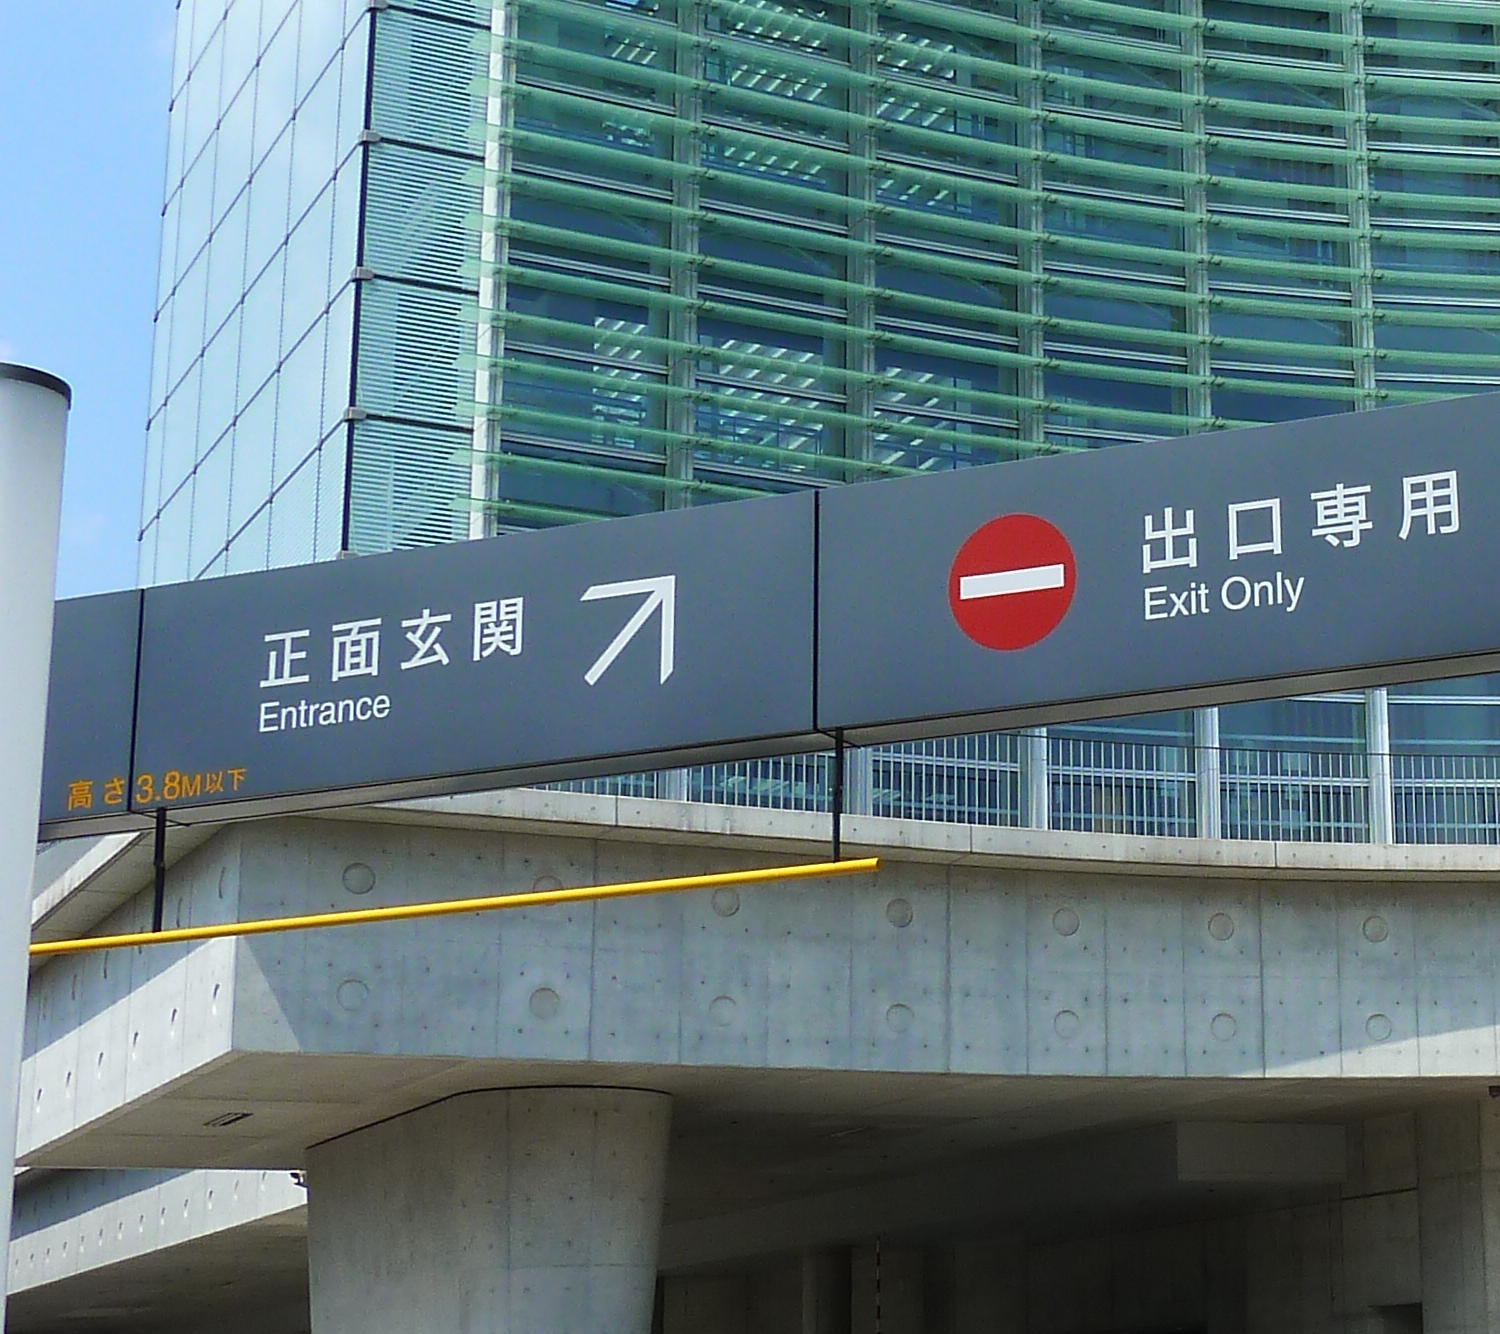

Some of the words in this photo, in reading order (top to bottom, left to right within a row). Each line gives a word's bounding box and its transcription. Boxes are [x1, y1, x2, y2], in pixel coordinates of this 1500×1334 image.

[1142, 470, 1460, 574] 出口専用
[1144, 582, 1210, 620] Exit
[1220, 571, 1305, 612] Only
[259, 596, 524, 688] 正面玄関
[259, 694, 391, 733] Entrance
